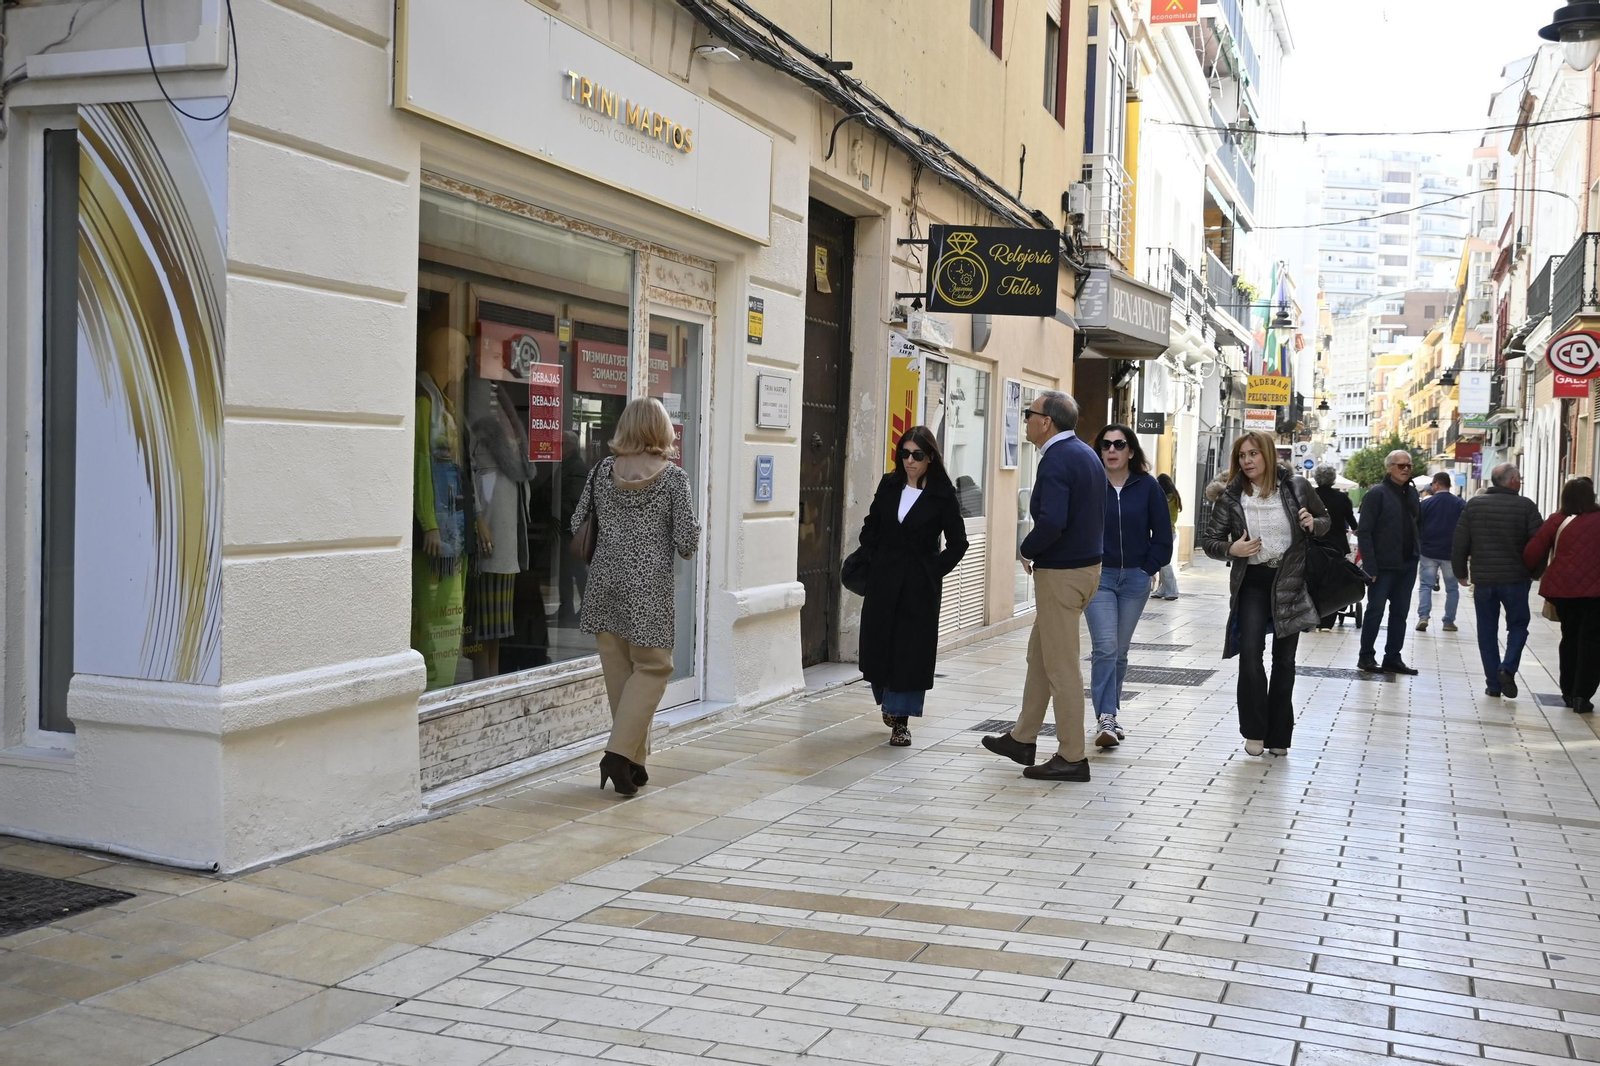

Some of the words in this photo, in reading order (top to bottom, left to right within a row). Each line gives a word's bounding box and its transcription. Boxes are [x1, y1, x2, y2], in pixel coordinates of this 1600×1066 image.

[566, 69, 619, 119] TRINI
[626, 98, 693, 154] MARTOS
[580, 113, 605, 137] MODA
[607, 127, 612, 138] Y
[613, 129, 675, 167] COMPLEMENTOS
[989, 243, 1054, 272] Relojería
[996, 275, 1043, 296] Taller
[1113, 287, 1167, 334] BENAVENTE
[532, 371, 560, 384] REBAJAS
[1249, 378, 1289, 390] ALDEMAR
[532, 395, 560, 407] REBAJAS
[1248, 393, 1287, 402] PELUQUEROS
[670, 411, 690, 420] MARTOS
[532, 419, 559, 430] REBAJAS
[539, 442, 552, 451] 50%
[439, 605, 466, 618] Martos
